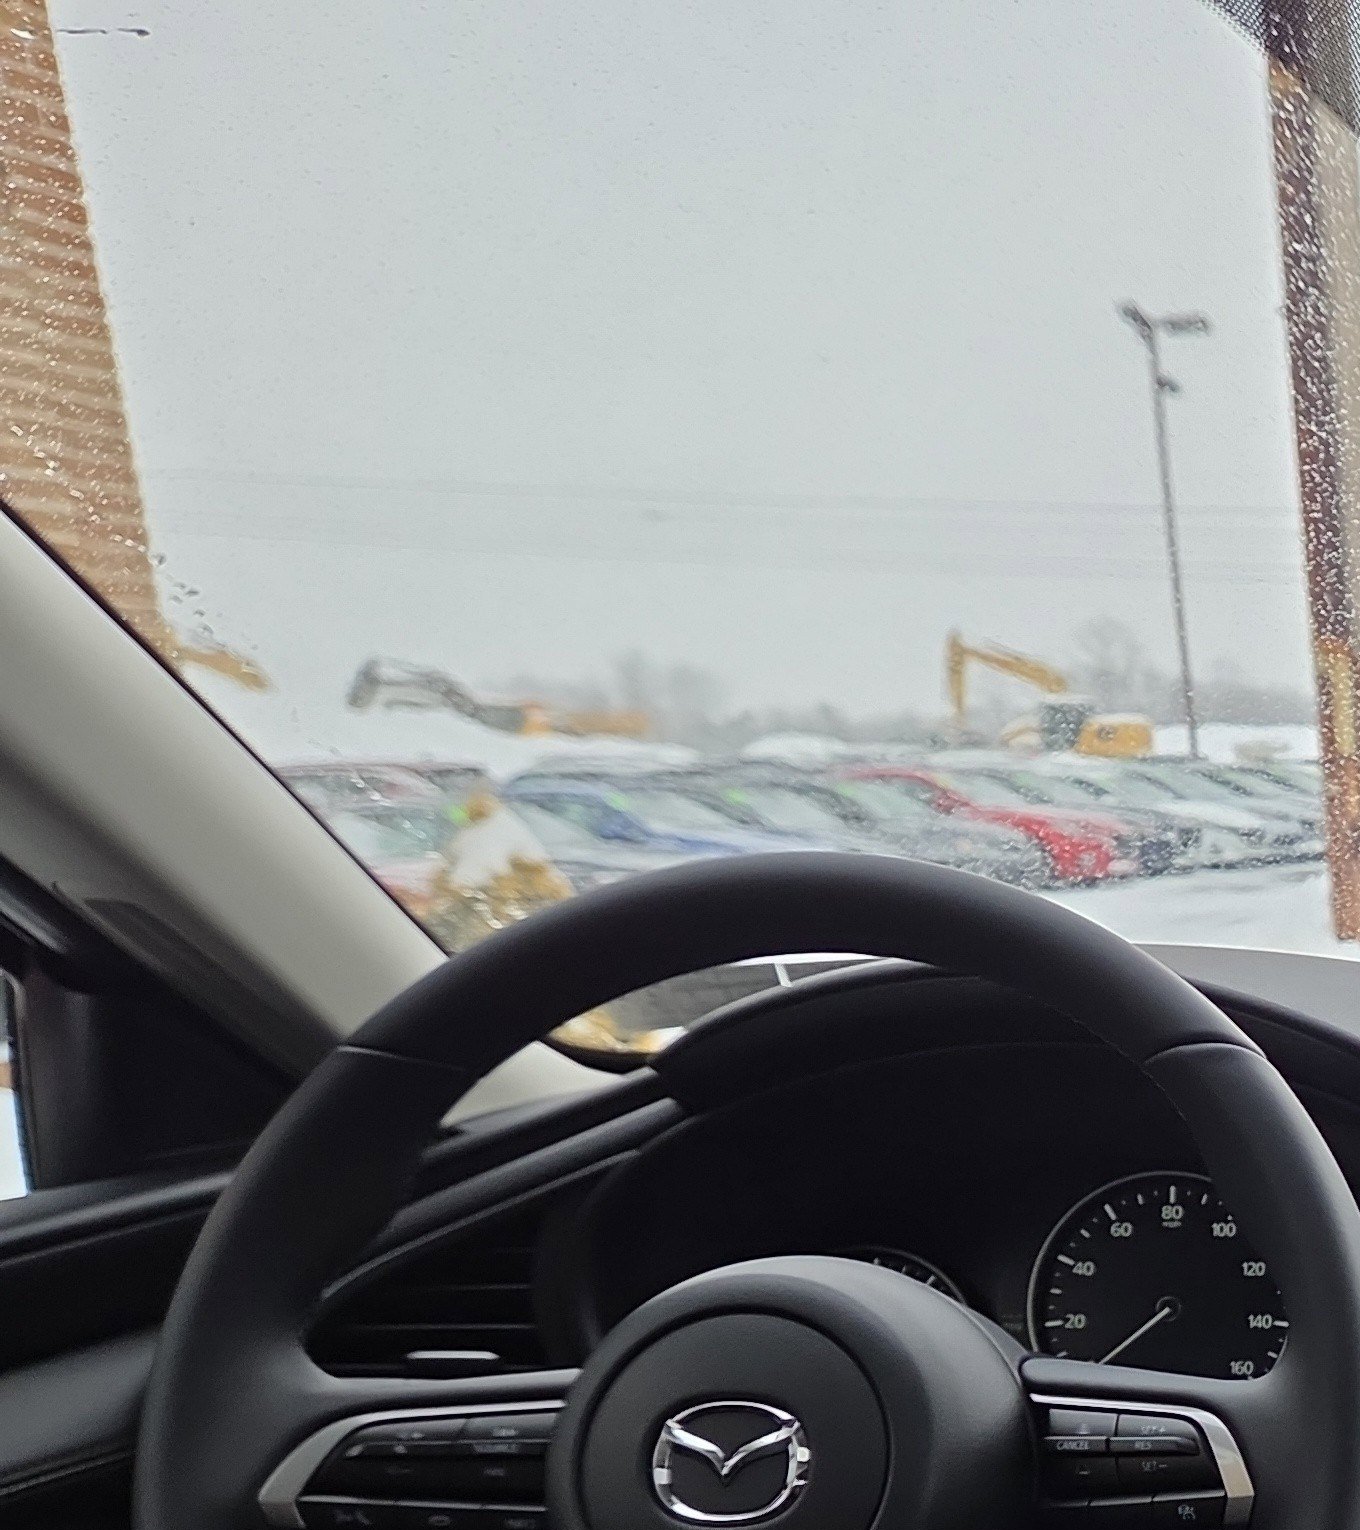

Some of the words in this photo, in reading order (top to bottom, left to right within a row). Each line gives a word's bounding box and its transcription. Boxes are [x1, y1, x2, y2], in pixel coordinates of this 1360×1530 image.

[1161, 1204, 1184, 1221] 80
[1110, 1221, 1134, 1238] 60
[1211, 1221, 1238, 1238] 100
[1072, 1260, 1096, 1277] 40
[1242, 1261, 1267, 1277] 120
[1064, 1313, 1087, 1330] 20
[1248, 1313, 1273, 1330] 140
[1230, 1360, 1254, 1376] 160
[1056, 1440, 1090, 1451] CANCEL
